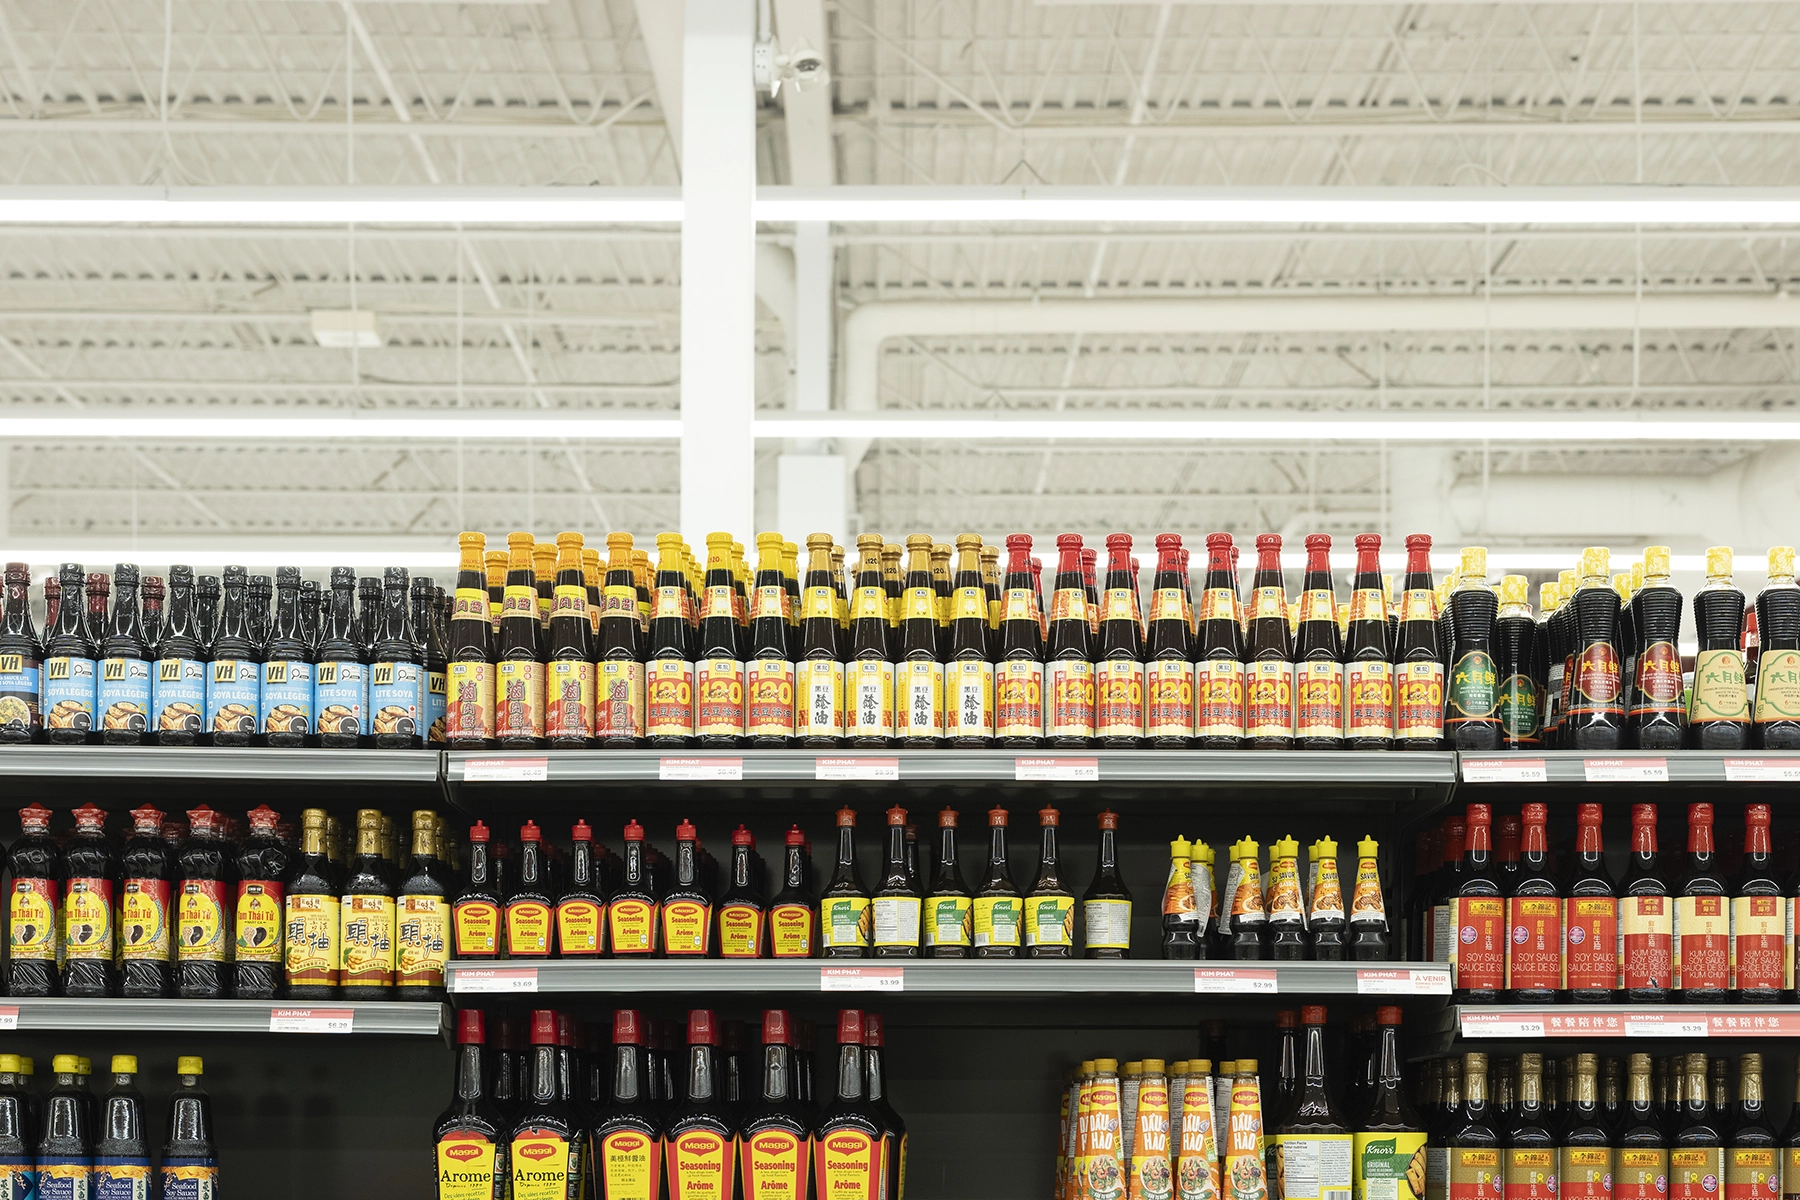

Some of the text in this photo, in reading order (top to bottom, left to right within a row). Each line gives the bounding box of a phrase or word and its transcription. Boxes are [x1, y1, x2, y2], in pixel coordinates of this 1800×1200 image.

[50, 662, 66, 676] VH
[319, 669, 336, 681] VH
[48, 687, 93, 698] SOYA LÉGÈRE
[701, 681, 742, 704] 120
[997, 682, 1040, 704] 120
[1401, 683, 1439, 705] 120
[1322, 872, 1337, 880] SAVOR
[251, 910, 265, 920] Thái
[618, 916, 643, 924] Seasoning
[1518, 953, 1558, 961] SOY SAUCE
[1415, 973, 1421, 982] À
[1551, 1017, 1618, 1028] 餐餐陪伴您
[1144, 1133, 1165, 1151] HÀO
[450, 1149, 479, 1157] Maggi
[1366, 1146, 1393, 1154] Knorr
[680, 1161, 721, 1172] Seasoning
[441, 1170, 491, 1183] Arome
[46, 1181, 72, 1189] Seafood
[687, 1180, 714, 1190] Arôme
[41, 1189, 50, 1197] Soy
